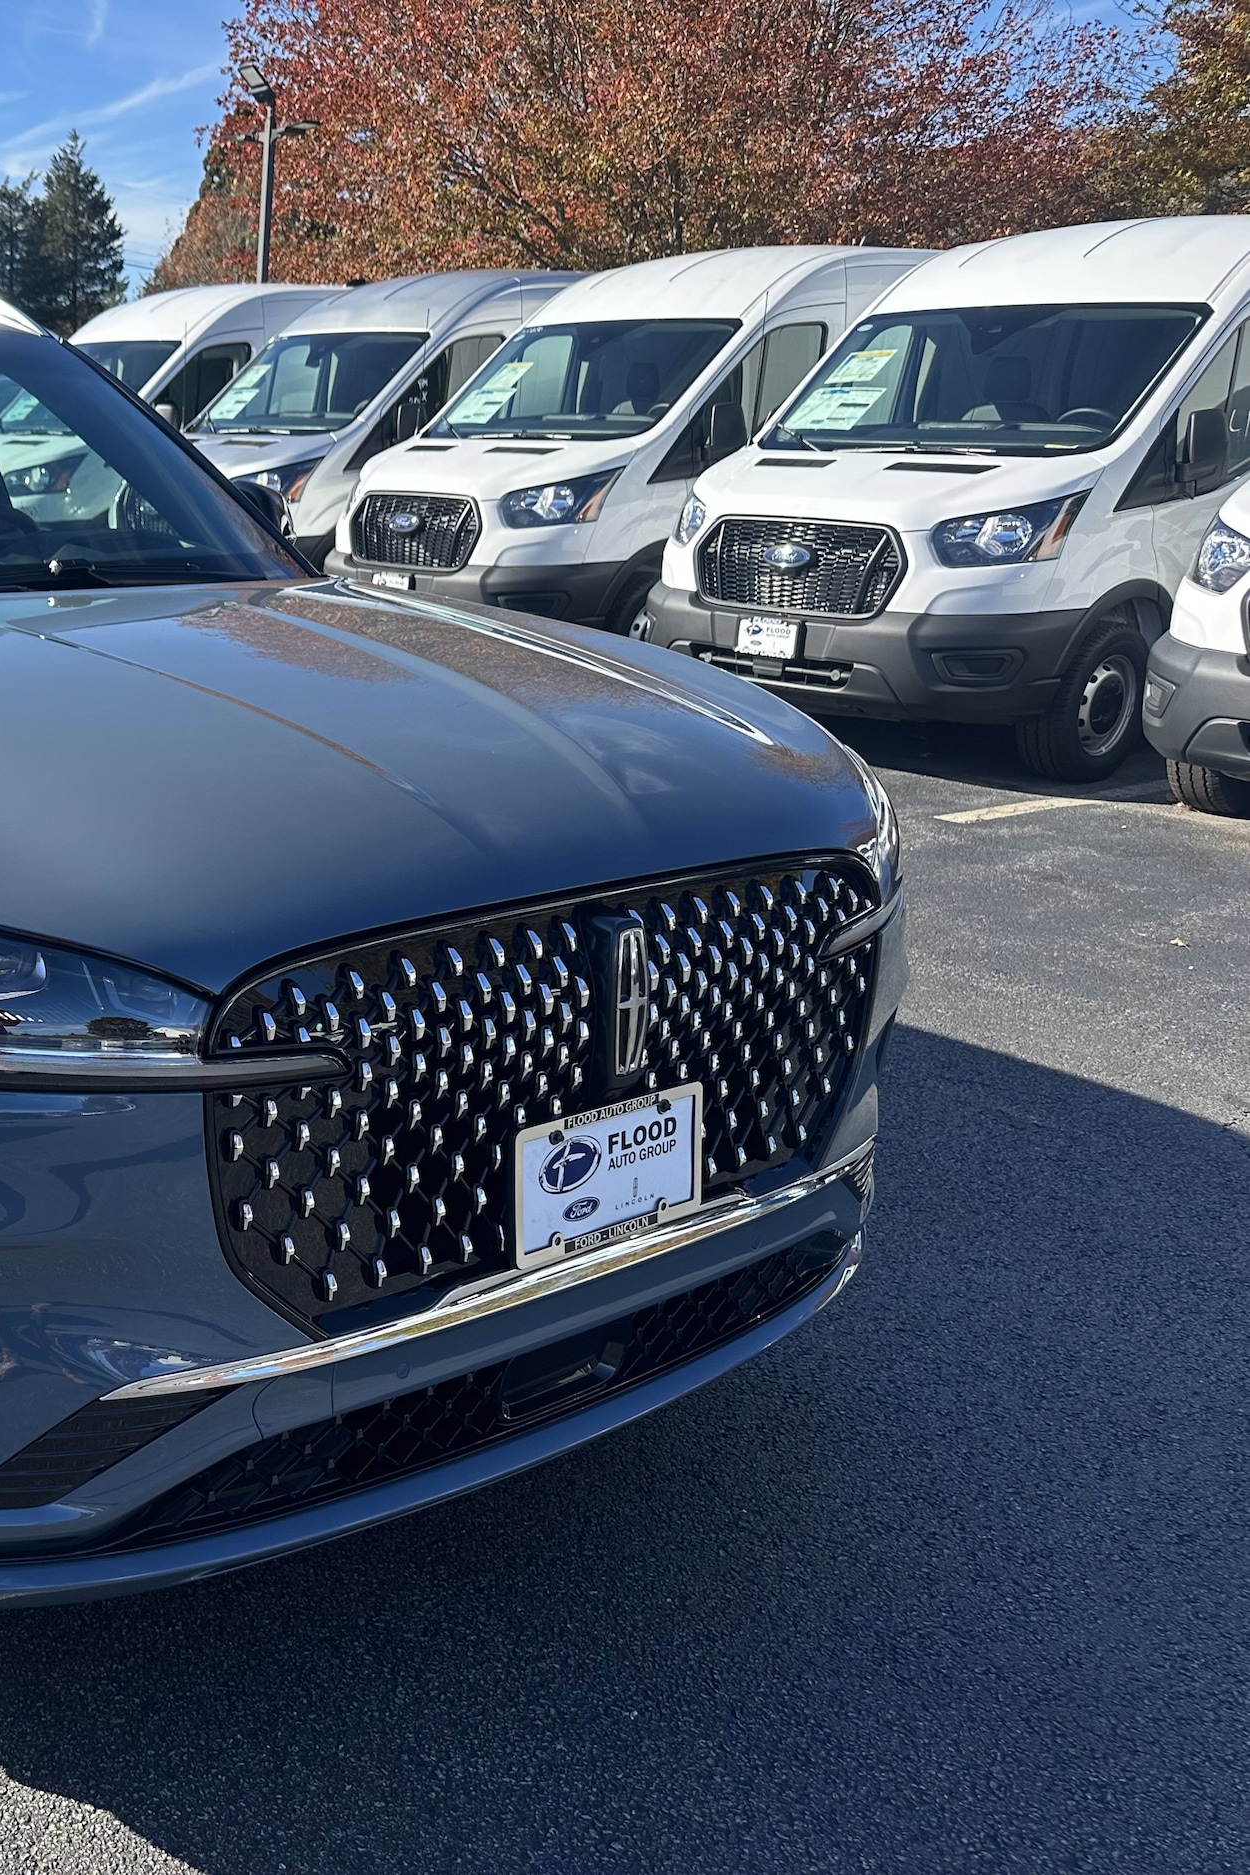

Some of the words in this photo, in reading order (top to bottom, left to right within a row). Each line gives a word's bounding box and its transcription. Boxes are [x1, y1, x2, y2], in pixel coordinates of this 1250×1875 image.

[567, 1111, 599, 1129] FLOOD
[599, 1104, 624, 1119] AUTO
[625, 1095, 656, 1112] GROUP
[608, 1117, 677, 1155] FLOOD
[608, 1151, 636, 1171] AUTO
[639, 1139, 677, 1161] GROUP
[570, 1201, 593, 1219] Ford
[615, 1193, 655, 1210] LINCOLN
[574, 1232, 601, 1250] FORD
[609, 1216, 649, 1238] LINCOLN
